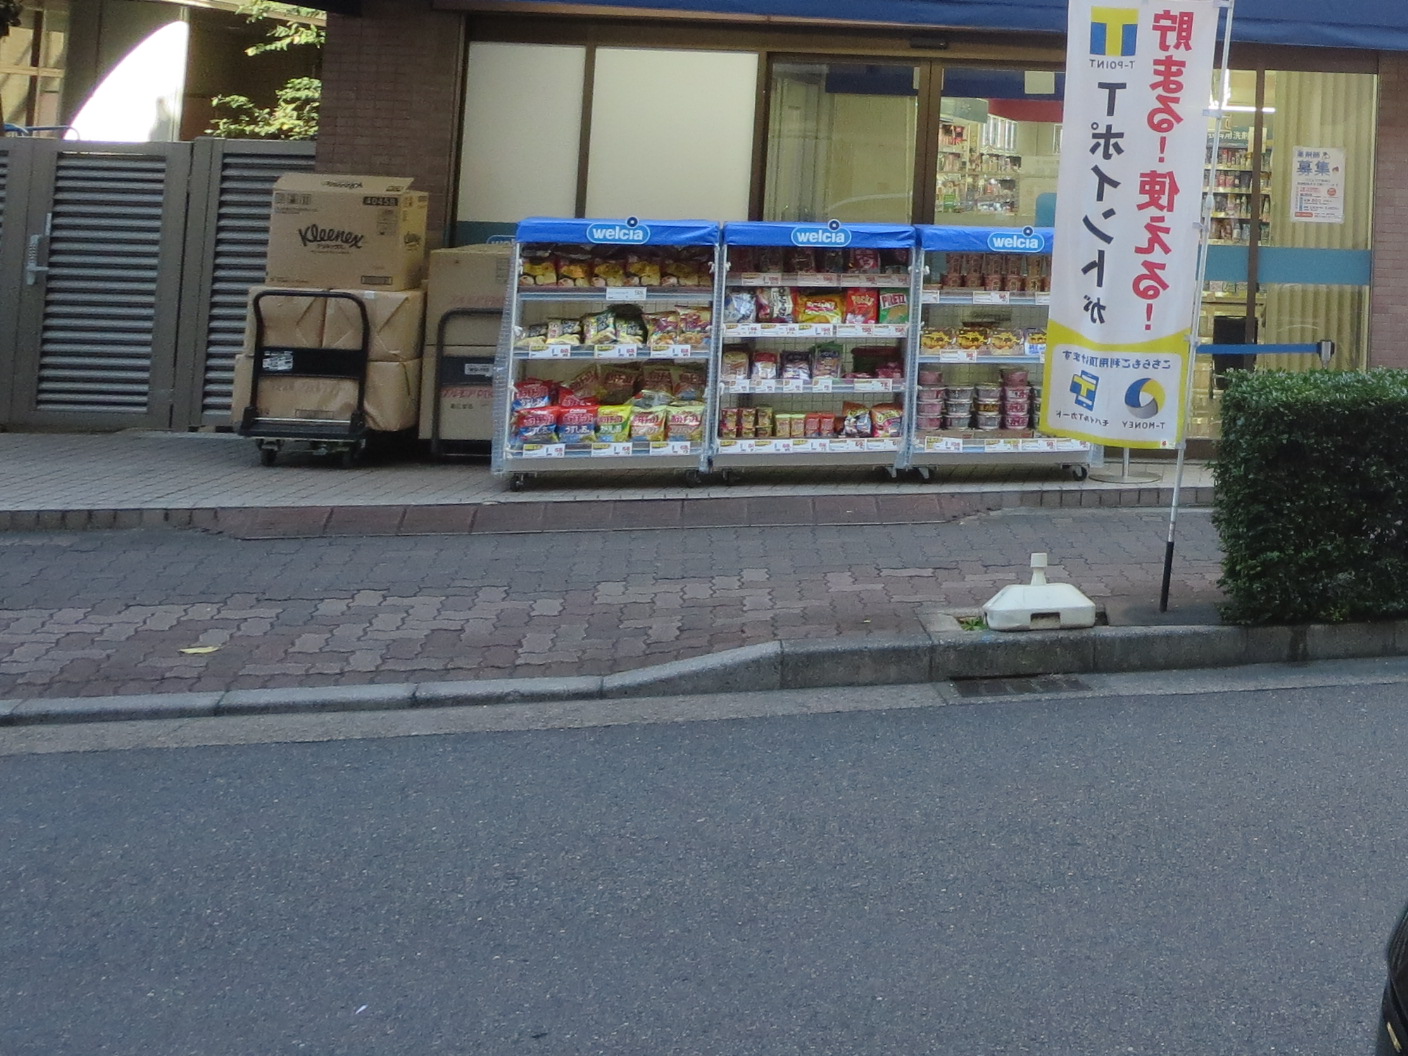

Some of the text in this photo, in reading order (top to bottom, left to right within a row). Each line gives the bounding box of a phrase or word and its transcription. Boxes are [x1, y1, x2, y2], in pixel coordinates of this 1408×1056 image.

[1297, 160, 1330, 177] 募集
[298, 223, 365, 249] Kleenex
[592, 225, 644, 241] welcia
[796, 229, 845, 243] welcia
[992, 235, 1039, 249] welcia
